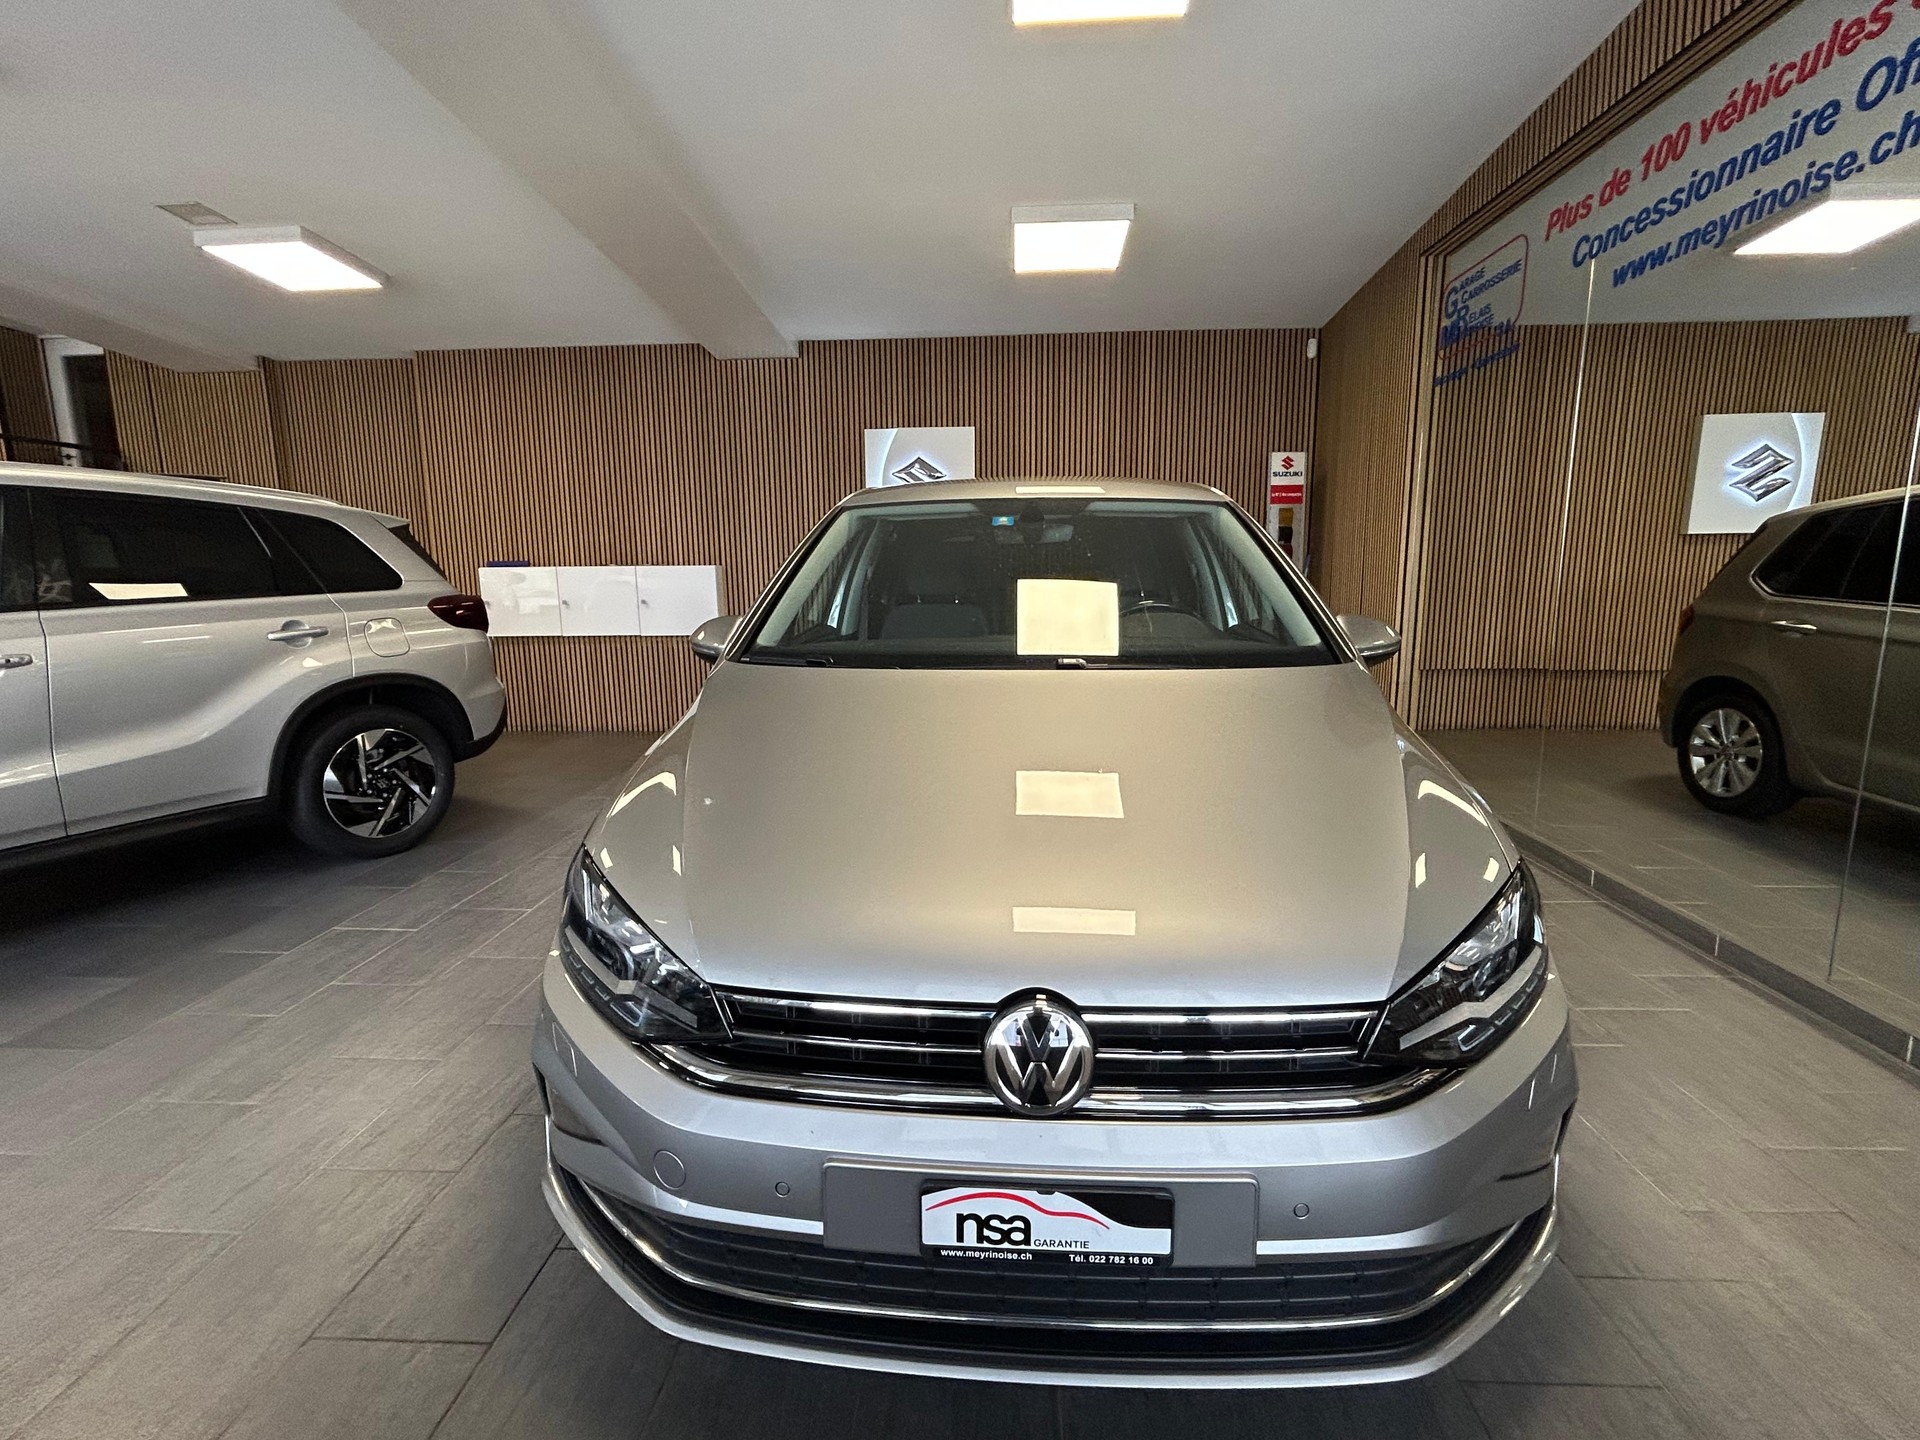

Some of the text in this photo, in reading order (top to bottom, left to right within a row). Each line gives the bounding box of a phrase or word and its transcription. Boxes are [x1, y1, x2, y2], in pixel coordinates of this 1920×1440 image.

[1545, 0, 1895, 242] Plus de 100 véhicules
[1572, 98, 1841, 268] Concessionnaire
[1612, 110, 1920, 288] www.meyrinoise.ch
[1461, 259, 1522, 304] CARROSSERIE
[956, 1212, 1031, 1247] nsa
[1033, 1238, 1090, 1249] GARANTIE
[940, 1249, 1033, 1261] www.meyrinoise.ch
[1068, 1254, 1154, 1265] Tél. 022 782 16 00
